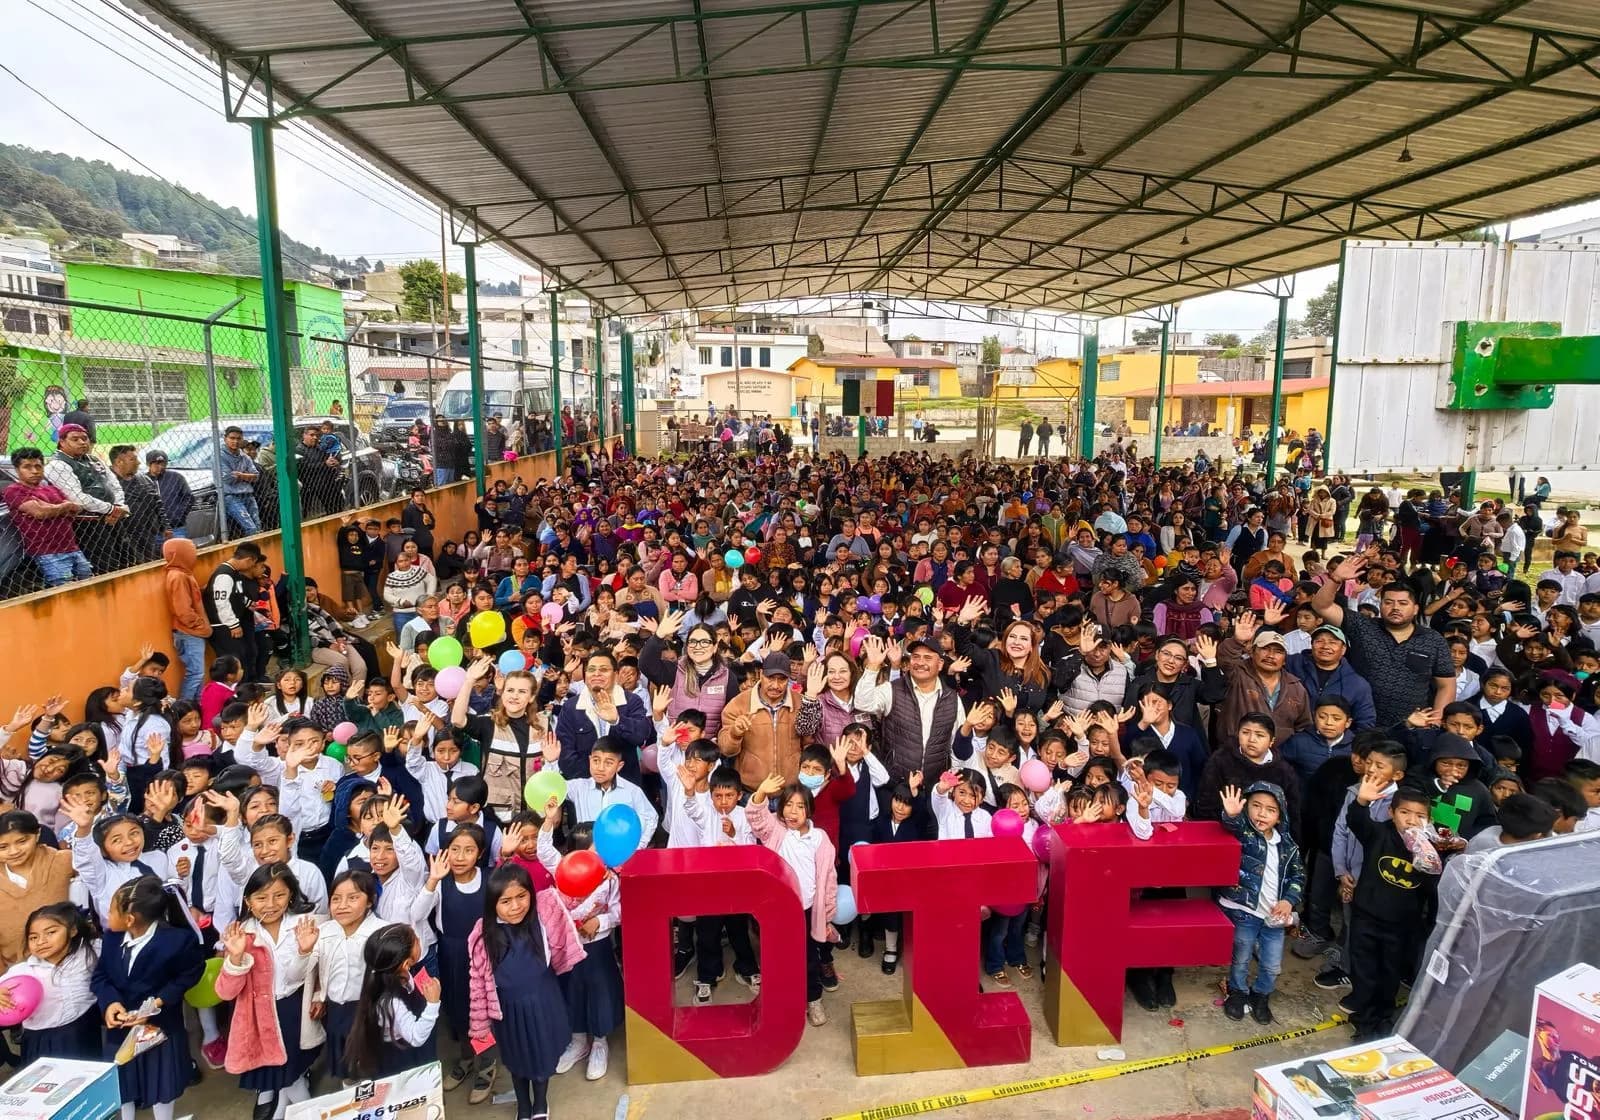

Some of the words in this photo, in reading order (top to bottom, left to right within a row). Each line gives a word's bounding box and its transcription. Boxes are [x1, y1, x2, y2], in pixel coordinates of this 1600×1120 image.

[620, 821, 1241, 1085] DIF
[1485, 1060, 1509, 1082] Hamilton
[1503, 1048, 1523, 1063] Beach
[374, 1106, 385, 1117] 6
[388, 1095, 427, 1113] tazas
